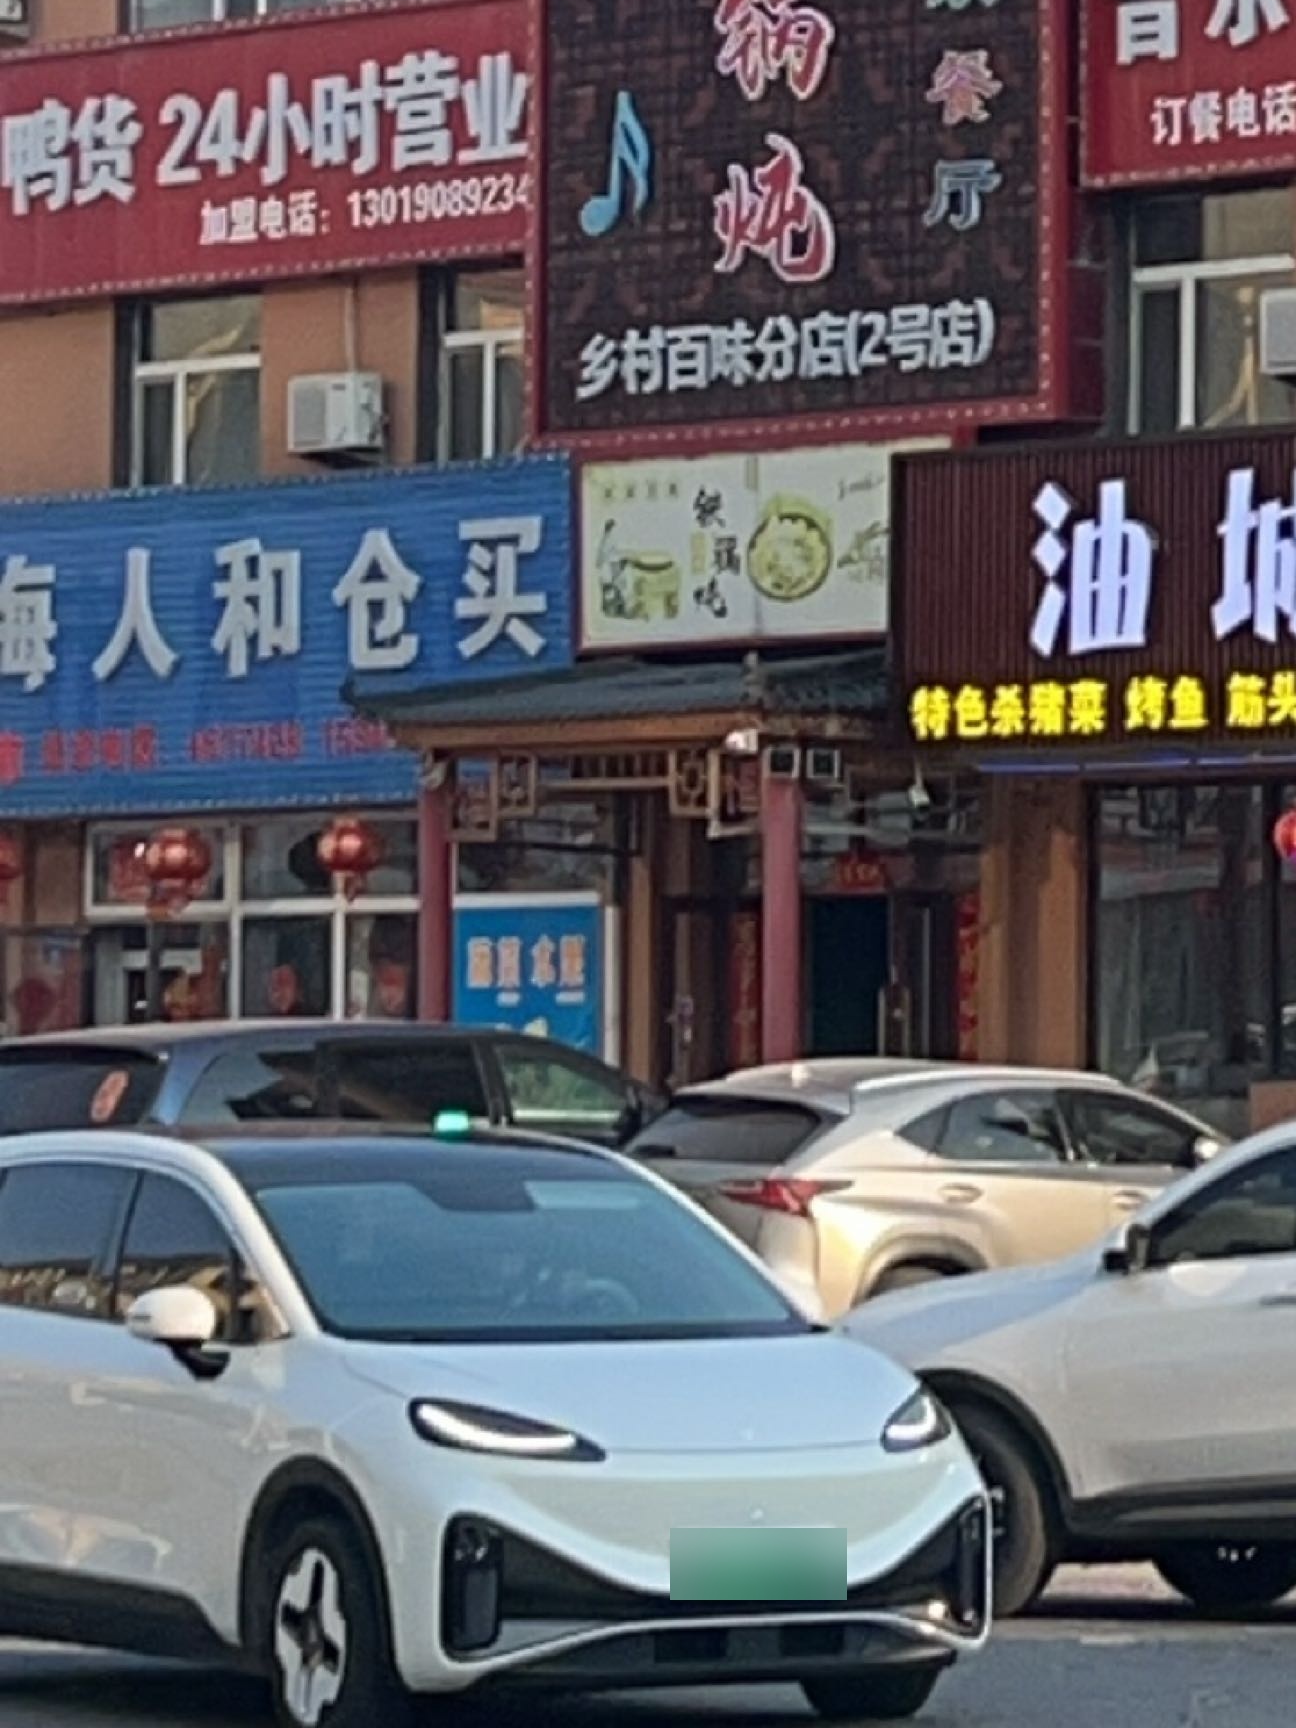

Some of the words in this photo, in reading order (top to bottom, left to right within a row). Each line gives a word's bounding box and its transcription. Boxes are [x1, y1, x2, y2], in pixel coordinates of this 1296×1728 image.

[910, 677, 1107, 741] 特色杀猪菜
[1123, 674, 1210, 731] 烤鱼
